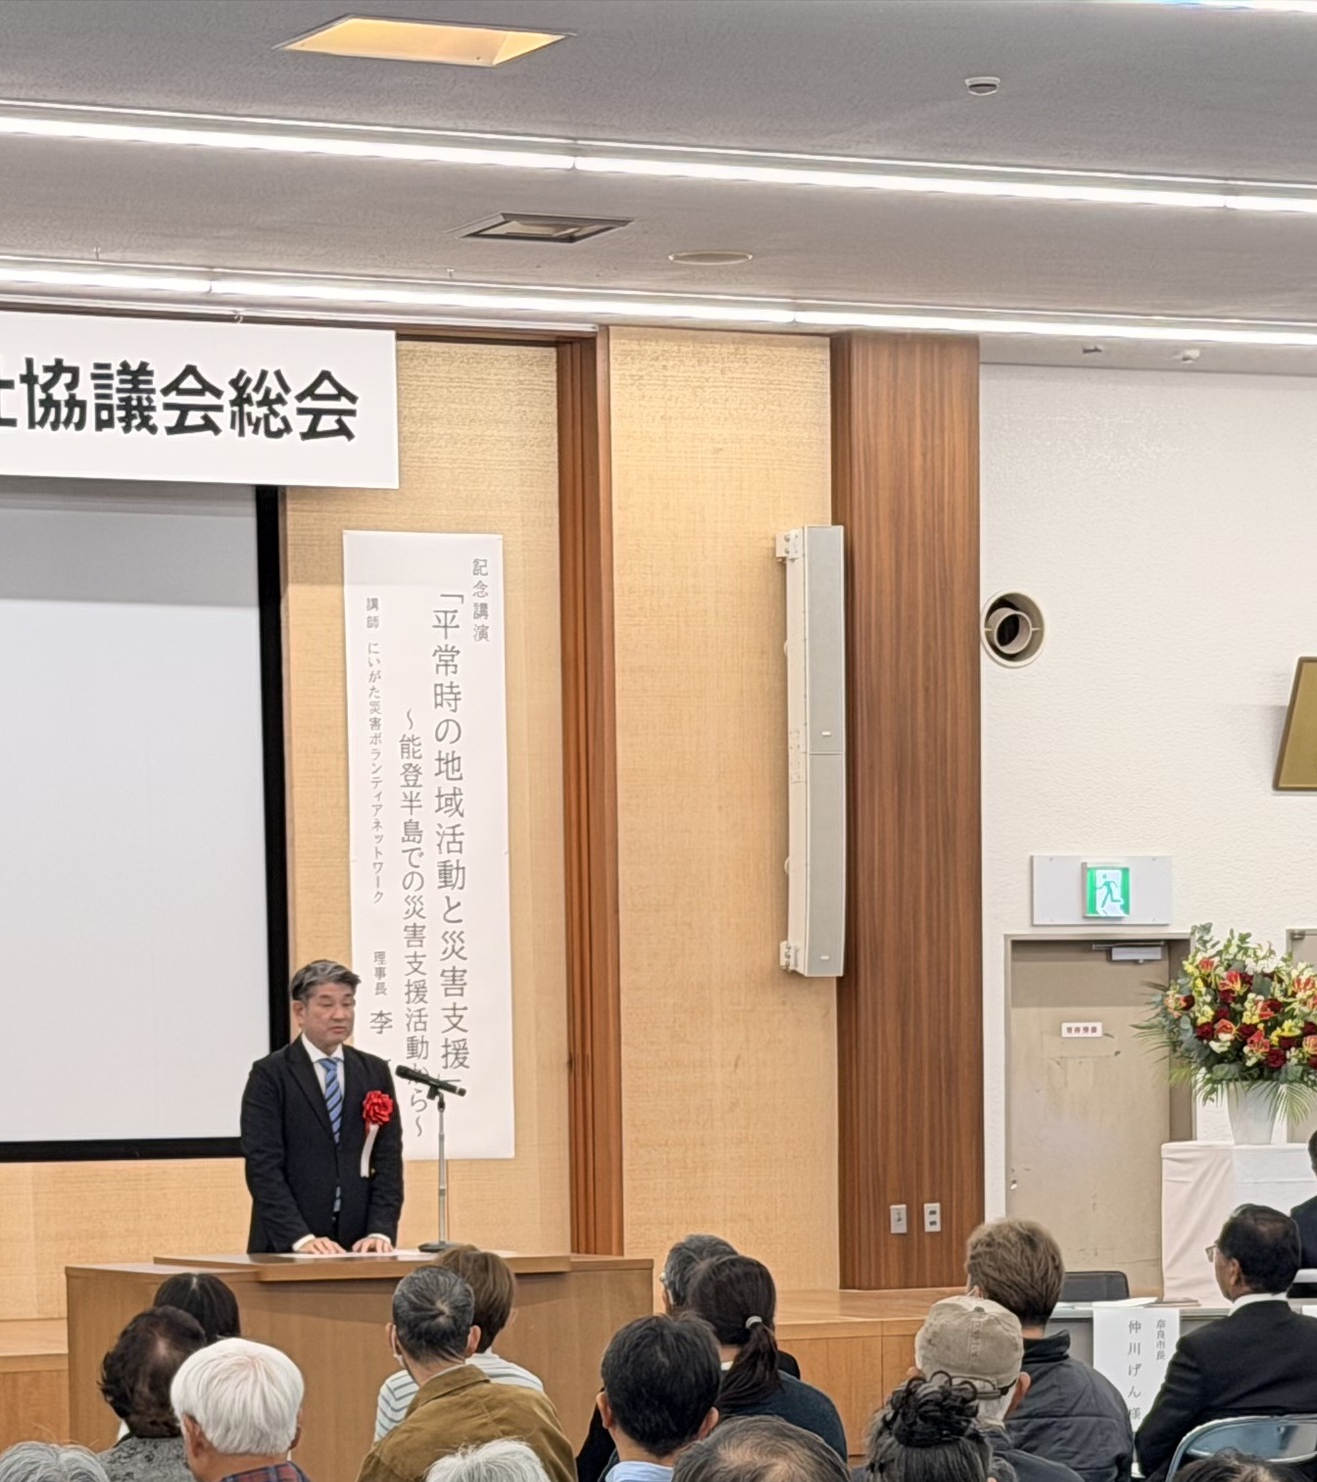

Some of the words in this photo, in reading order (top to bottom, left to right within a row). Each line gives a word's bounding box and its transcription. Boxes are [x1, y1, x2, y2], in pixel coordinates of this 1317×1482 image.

[366, 597, 380, 629] 講師
[471, 558, 490, 643] 記念講演
[373, 950, 387, 996] 理事長
[369, 1009, 393, 1035] 李
